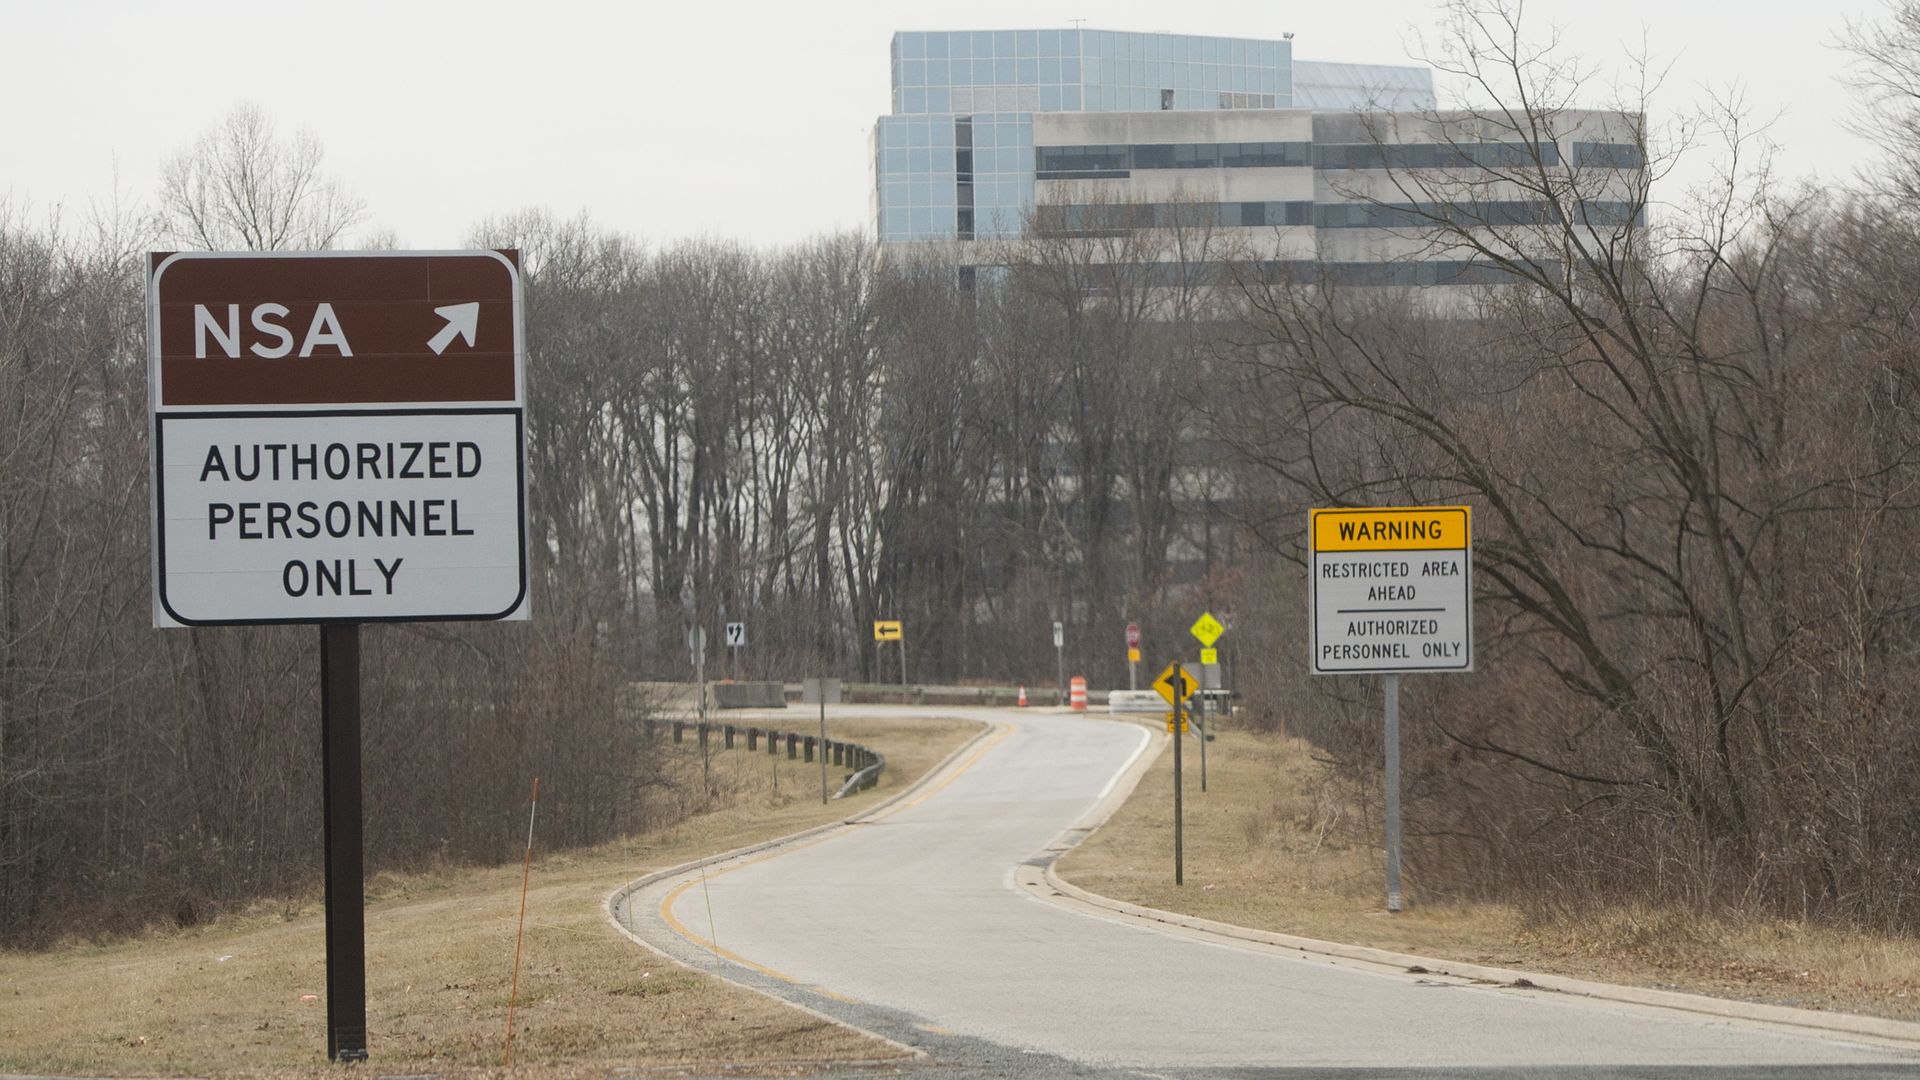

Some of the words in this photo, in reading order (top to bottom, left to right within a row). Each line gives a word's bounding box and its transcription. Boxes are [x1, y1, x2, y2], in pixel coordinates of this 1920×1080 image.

[194, 302, 354, 359] NSA
[200, 441, 482, 482] AUTHORIZED
[208, 499, 475, 540] PERSONNEL
[1339, 520, 1443, 541] WARNING
[282, 558, 404, 597] ONLY
[1322, 562, 1409, 578] RESTRICTED
[1421, 561, 1459, 576] AREA
[1367, 585, 1416, 601] AHEAD
[1347, 619, 1438, 636] AUTHORIZED
[1323, 643, 1410, 659] PERSONNEL
[1422, 642, 1461, 657] ONLY
